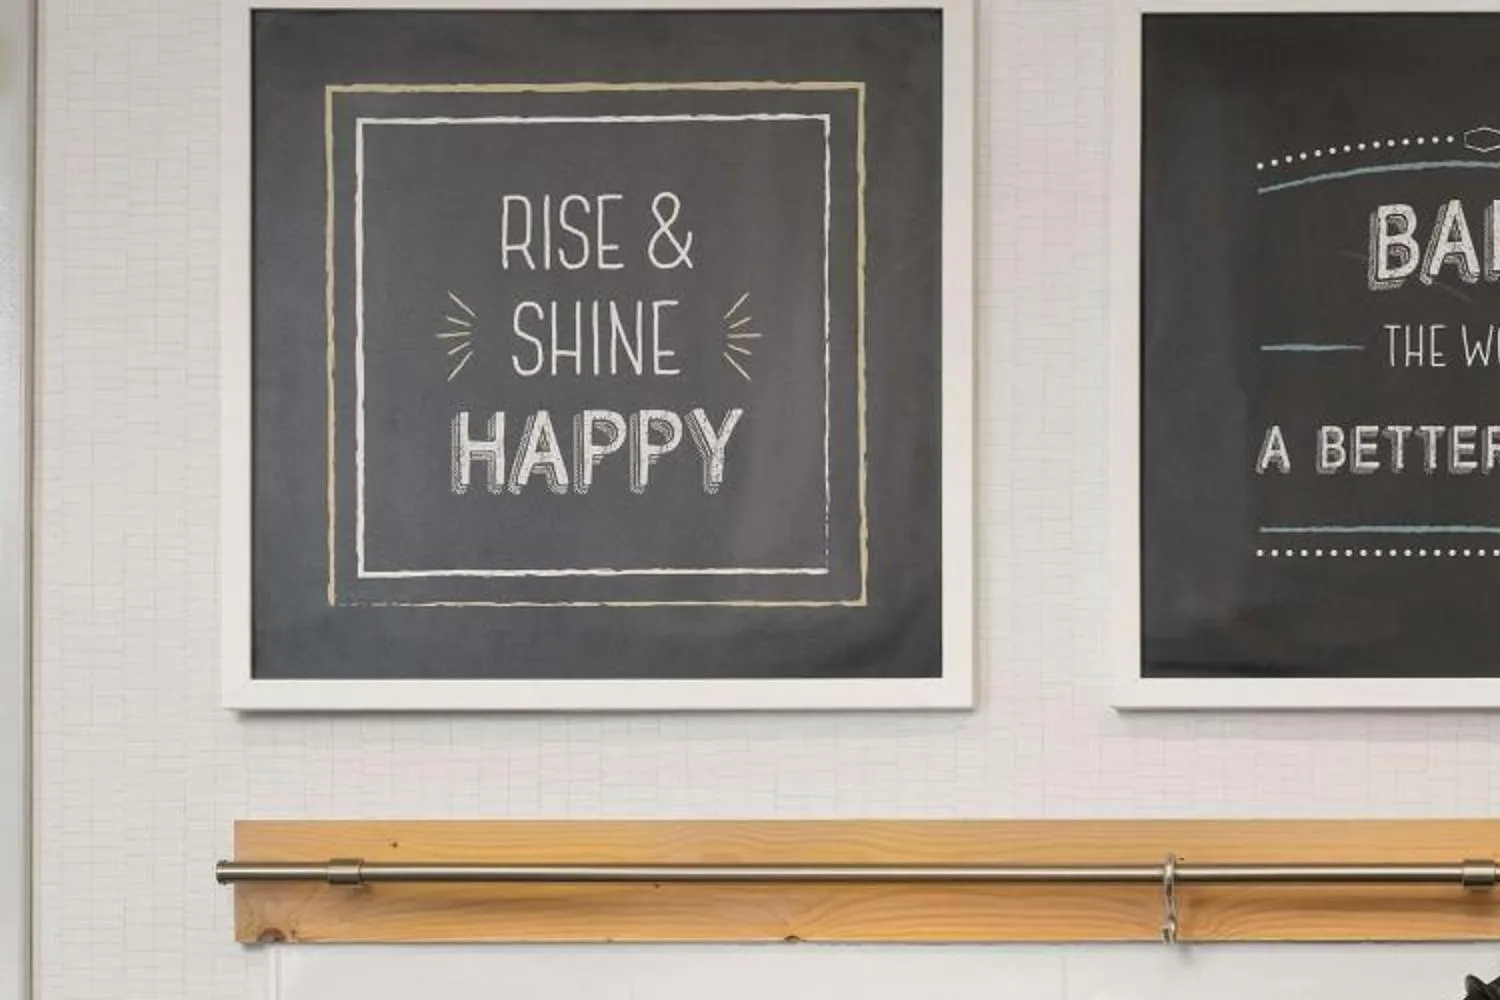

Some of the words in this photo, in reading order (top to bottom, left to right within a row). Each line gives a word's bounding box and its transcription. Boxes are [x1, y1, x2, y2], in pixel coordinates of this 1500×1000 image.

[501, 194, 625, 271] RISE
[648, 191, 694, 270] &
[511, 300, 680, 377] SHINE
[1384, 323, 1447, 368] THE
[450, 408, 744, 495] HAPPY
[1256, 425, 1292, 475] A
